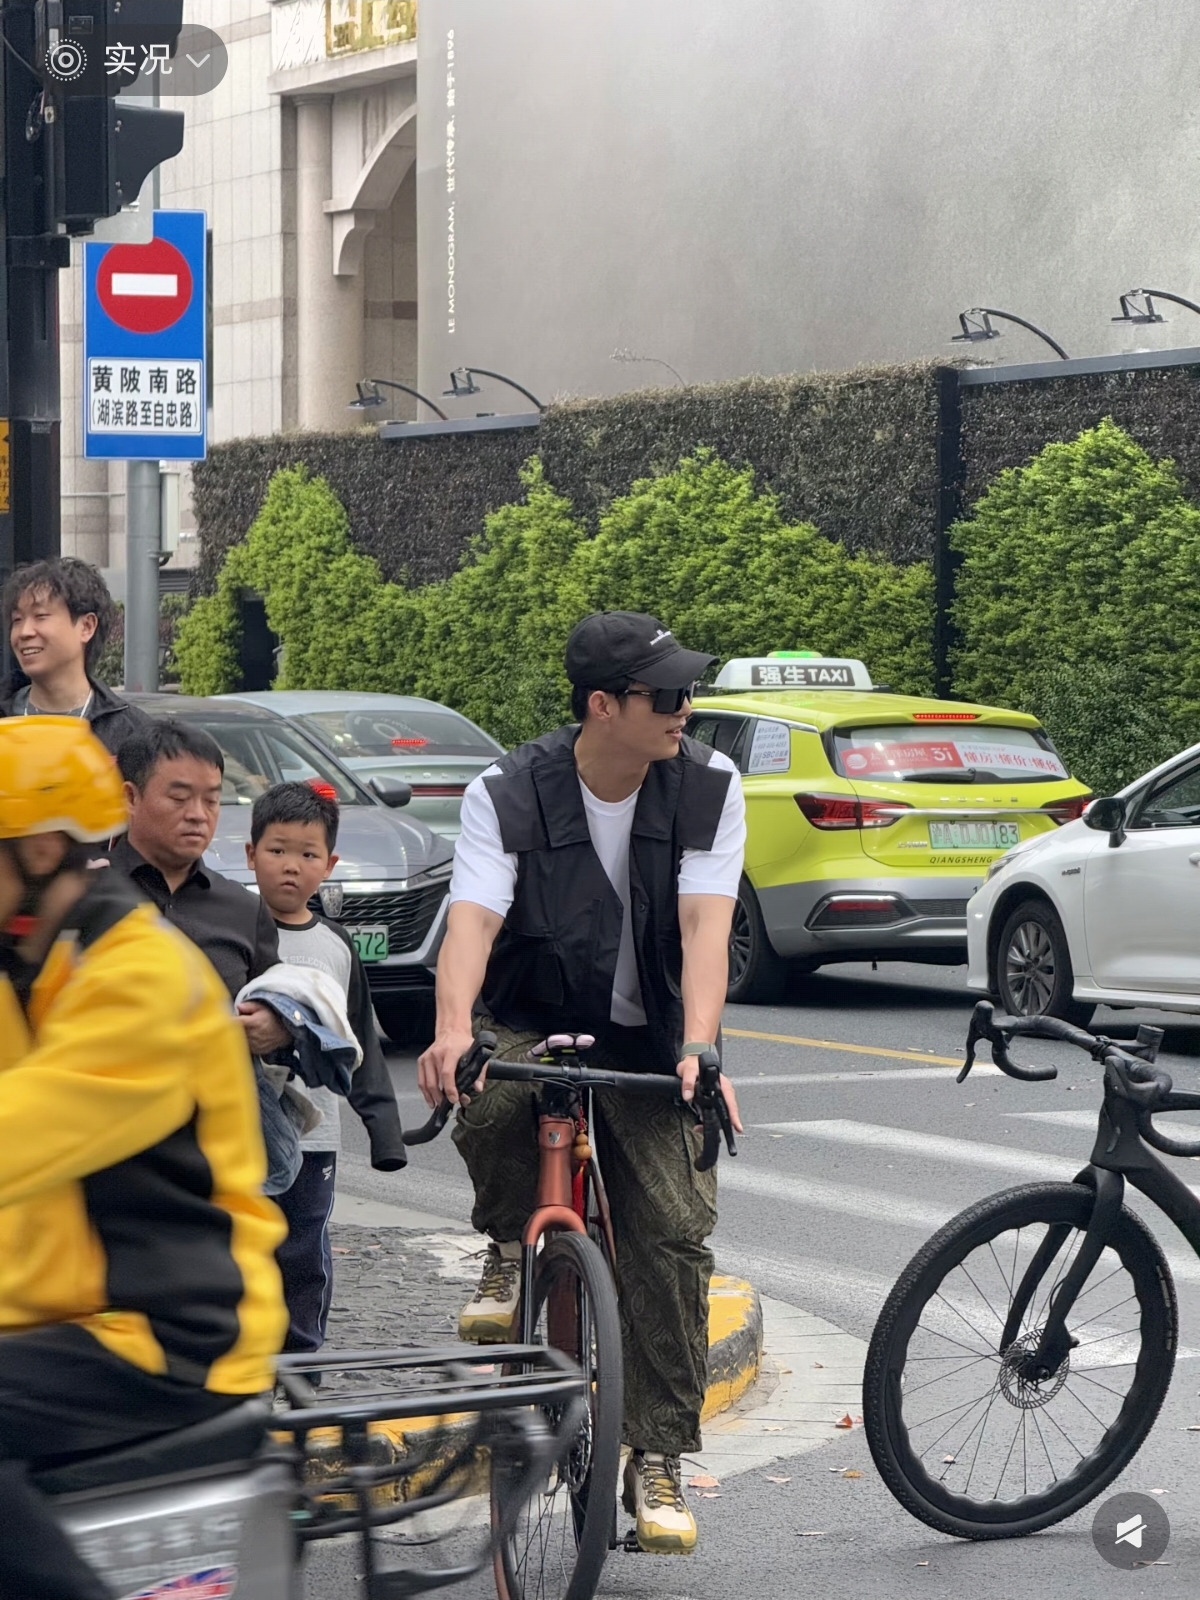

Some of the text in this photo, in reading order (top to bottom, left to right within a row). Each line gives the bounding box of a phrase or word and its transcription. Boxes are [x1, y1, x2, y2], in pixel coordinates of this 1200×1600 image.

[448, 318, 456, 334] LE
[92, 365, 197, 395] 黄陂南路
[929, 856, 993, 864] QIANGSHENG
